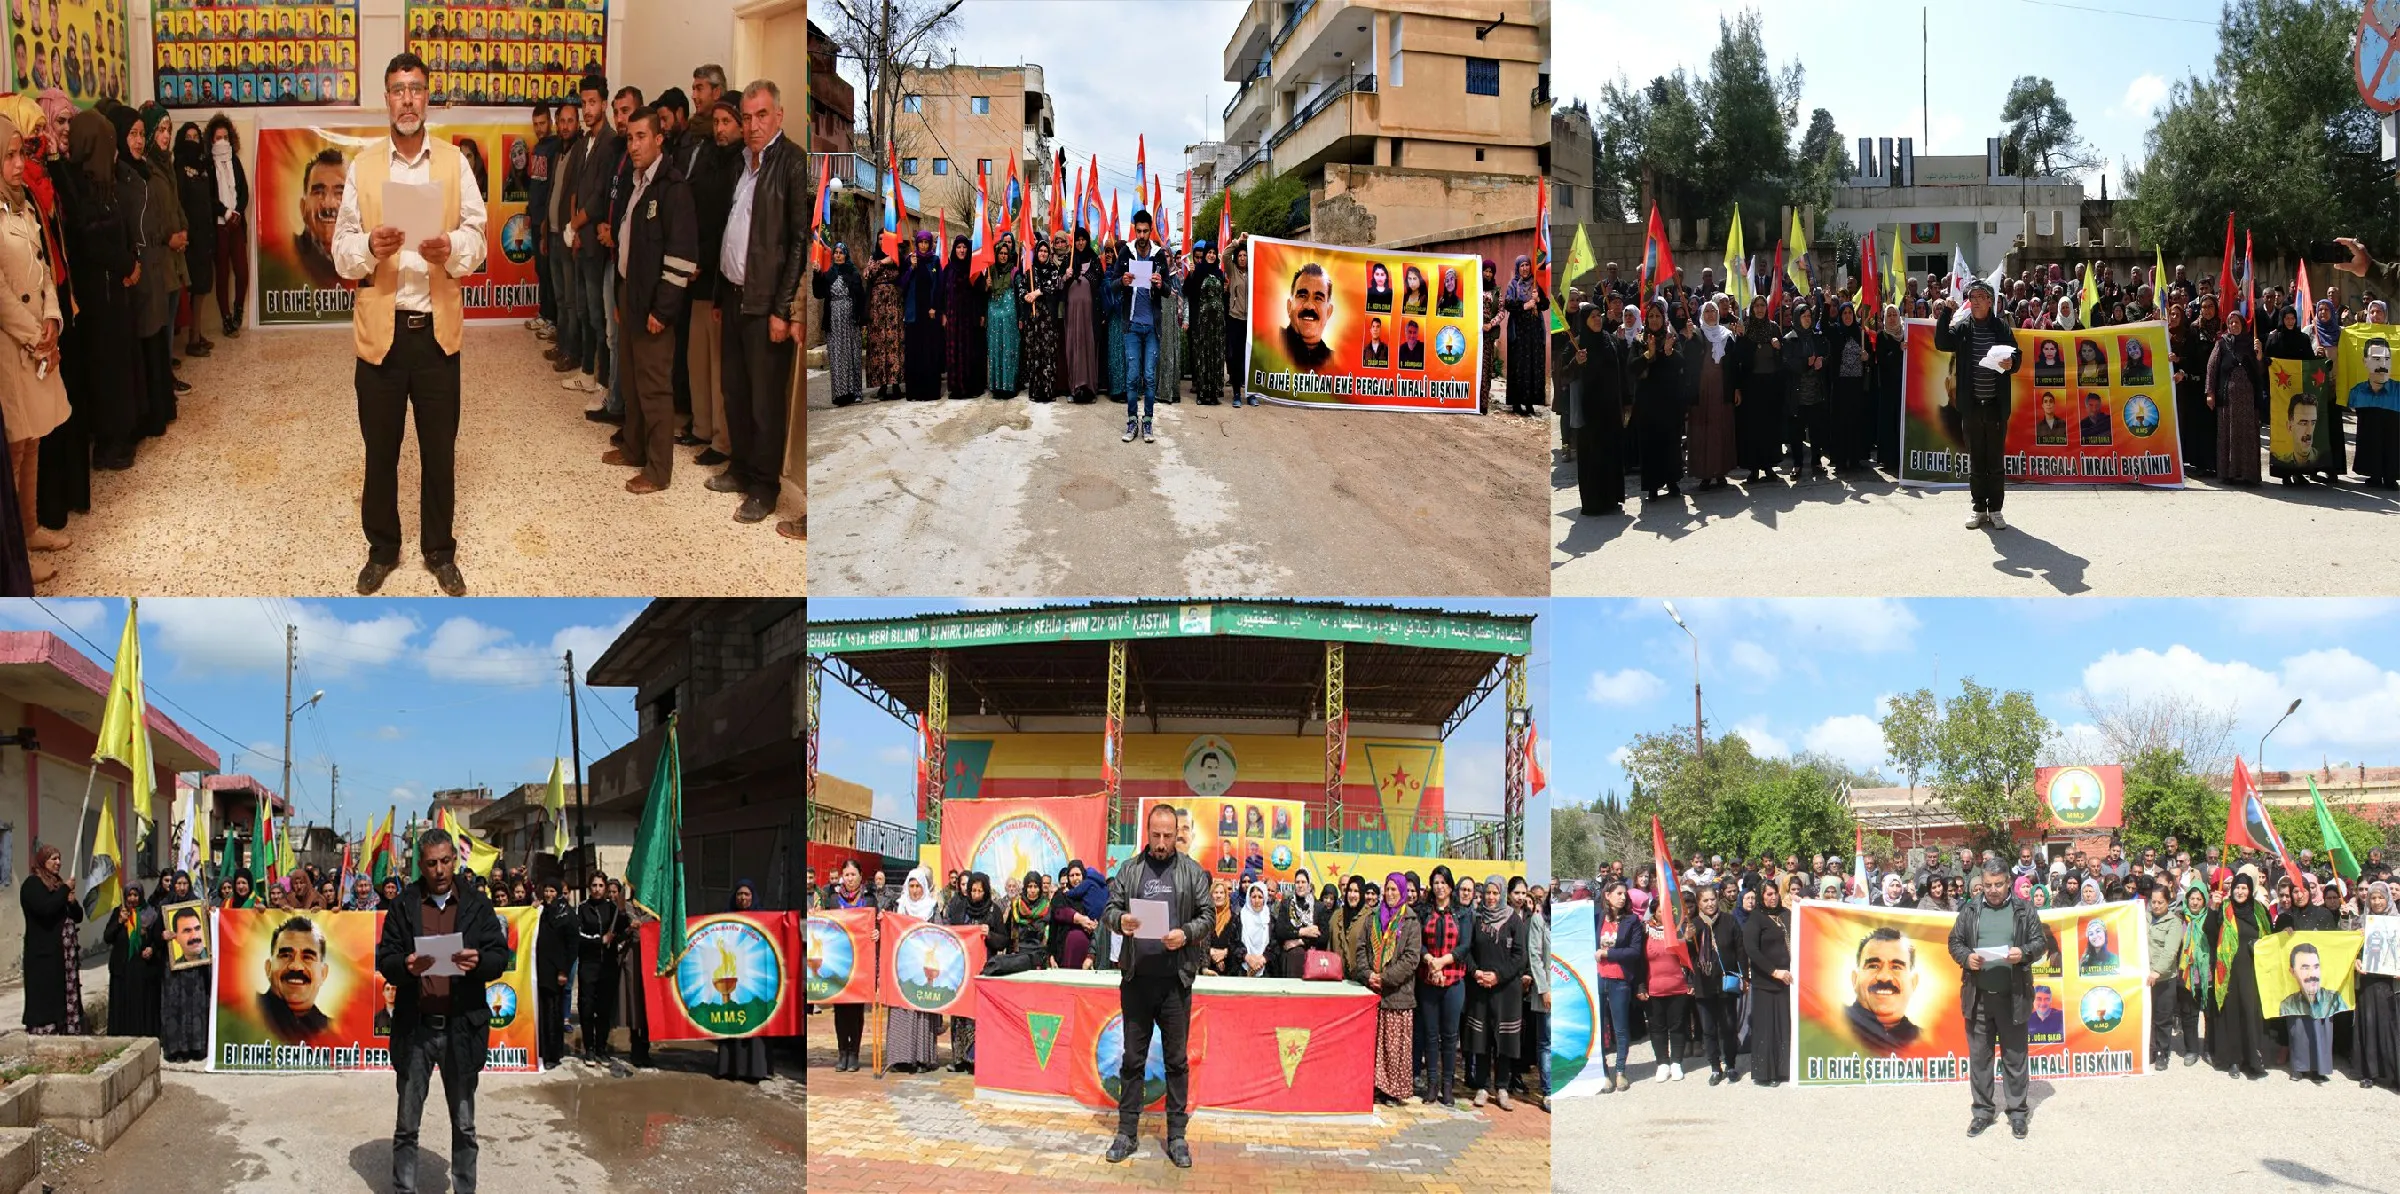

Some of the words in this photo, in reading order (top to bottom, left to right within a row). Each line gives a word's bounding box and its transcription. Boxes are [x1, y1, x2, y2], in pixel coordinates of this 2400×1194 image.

[267, 290, 280, 313] BI
[313, 283, 357, 318] ŞEHÎDA
[494, 278, 540, 312] BIŞKÎNI
[1255, 369, 1266, 387] BI
[1355, 377, 1395, 396] PERGALA
[1910, 450, 1923, 470] BI
[2029, 455, 2078, 476] PERGALA
[807, 631, 842, 648] EHADET
[223, 1042, 239, 1065] BI
[1808, 1056, 1824, 1080] BI
[2029, 1048, 2070, 1076] MRALÎ
